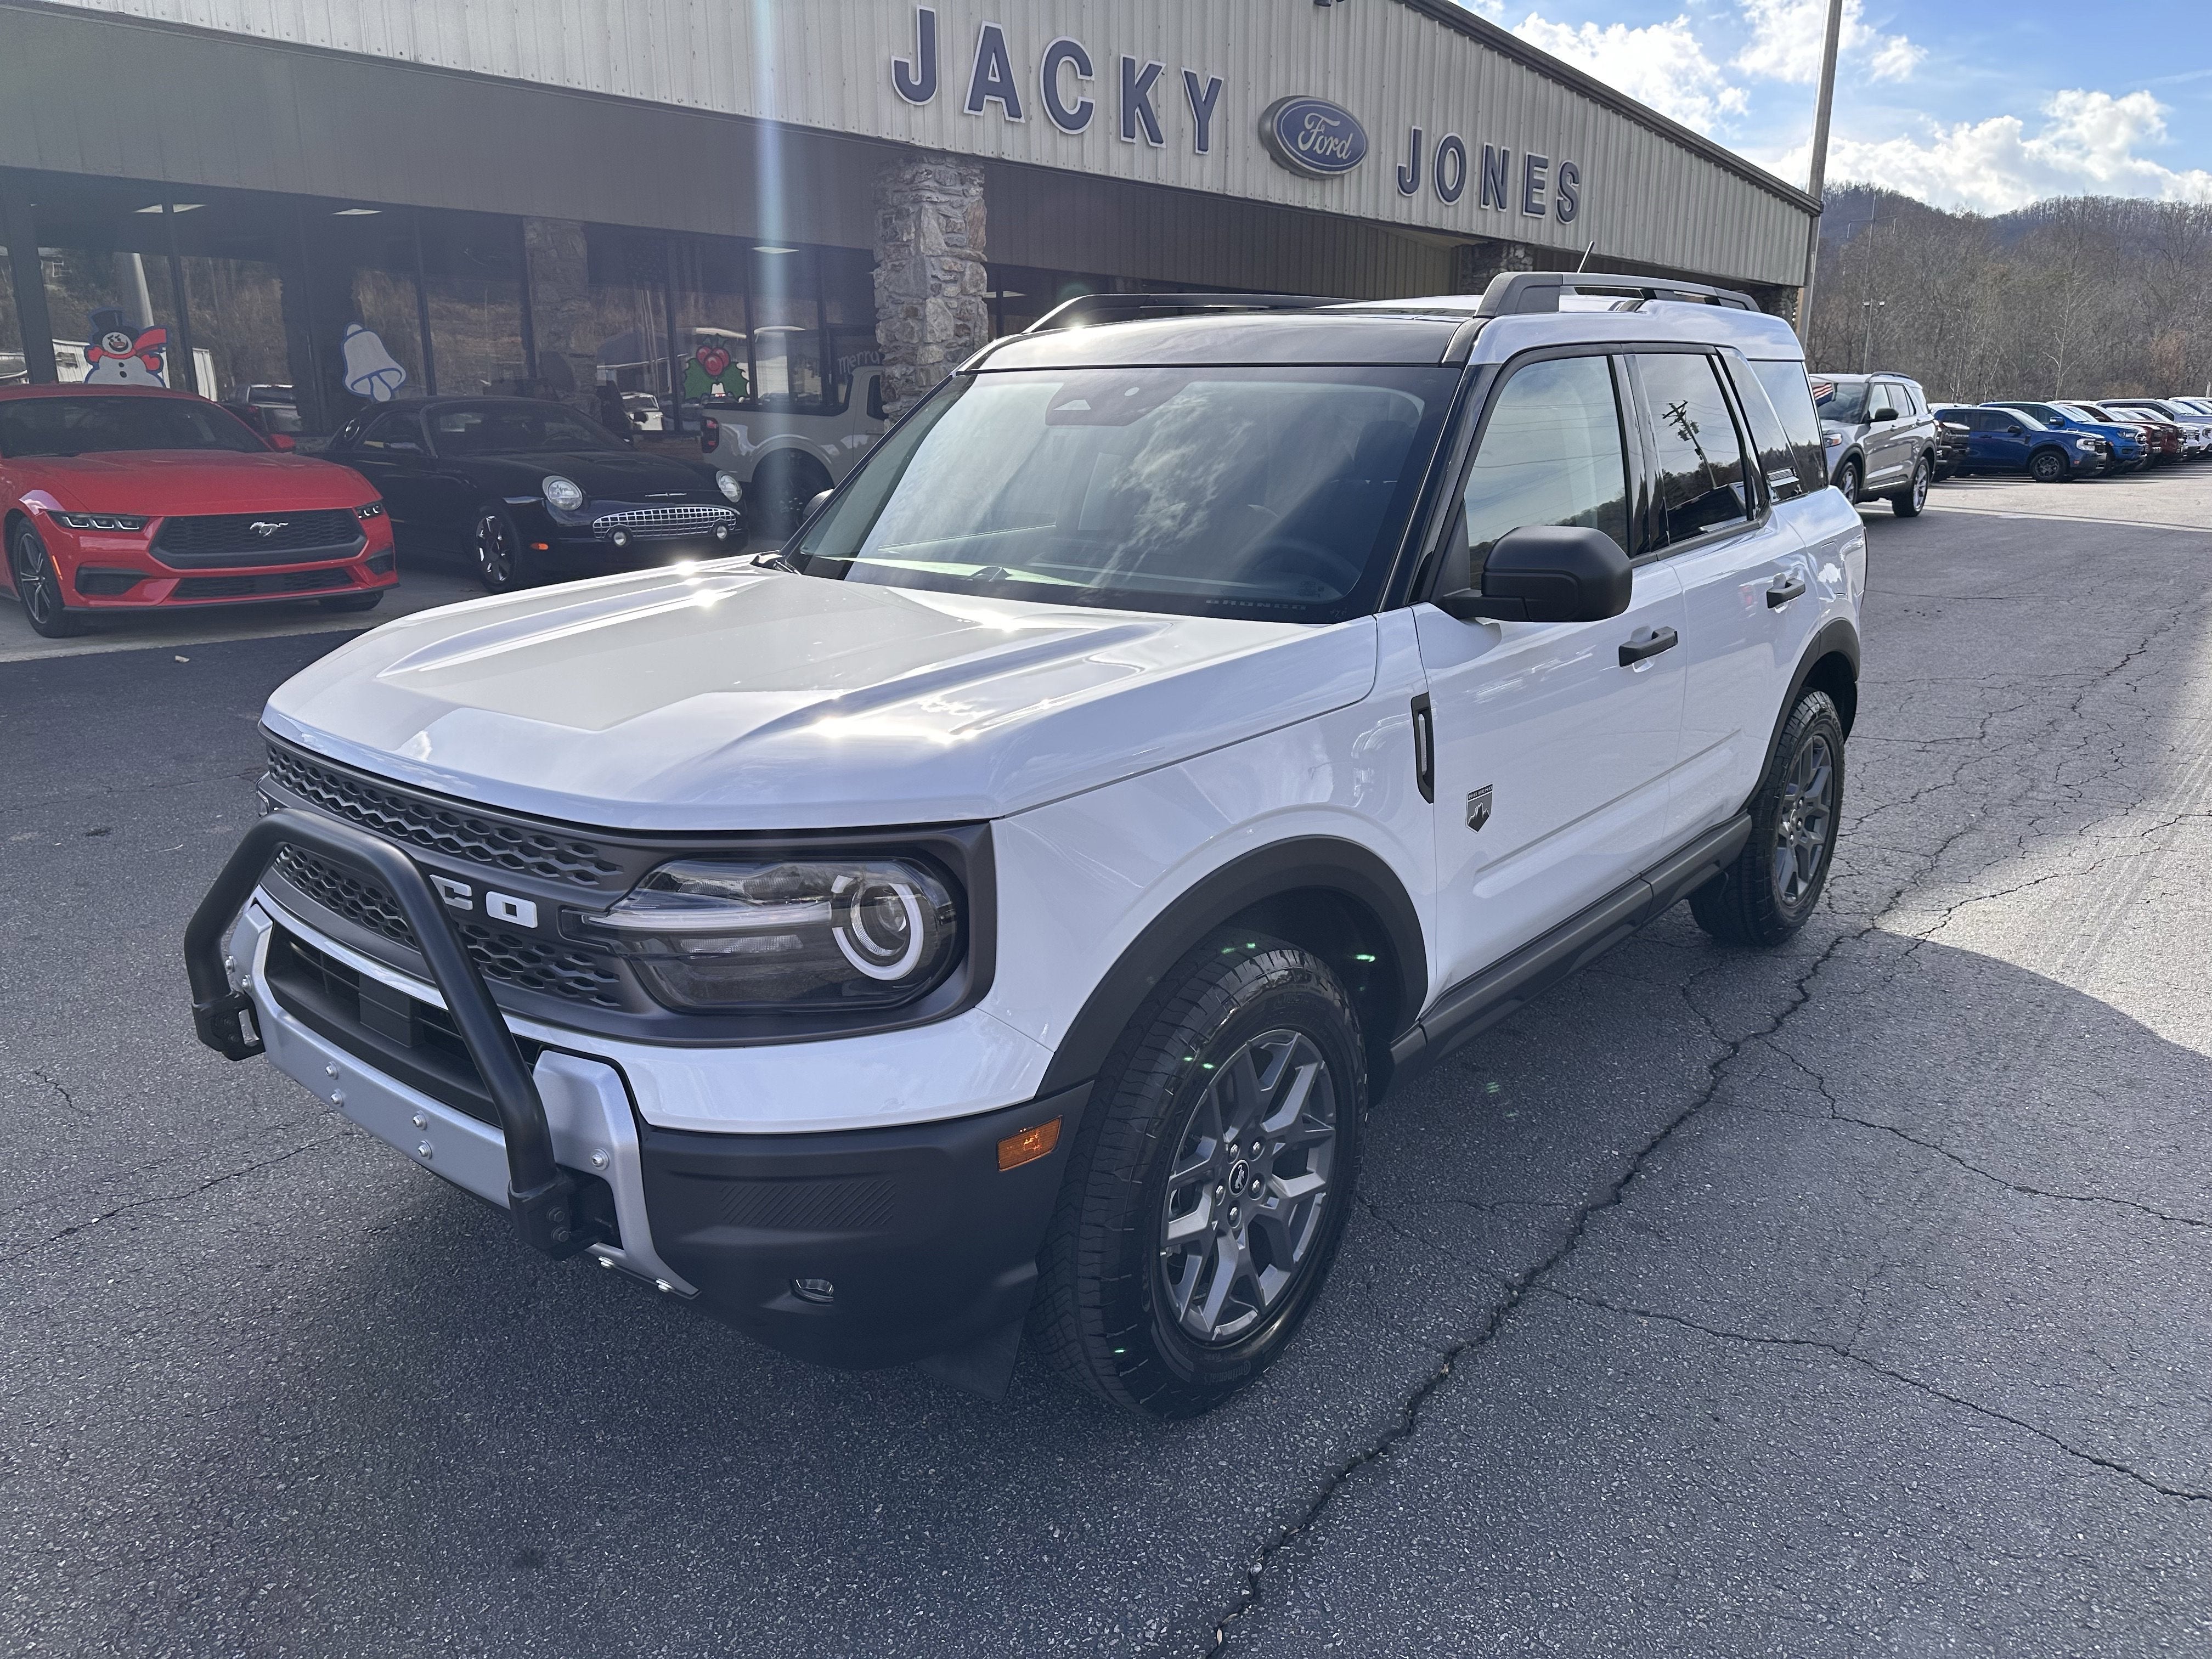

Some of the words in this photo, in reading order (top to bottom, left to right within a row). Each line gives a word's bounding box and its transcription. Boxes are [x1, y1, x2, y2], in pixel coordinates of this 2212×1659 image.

[891, 4, 1224, 154] JACKY
[1397, 126, 1579, 224] JONES
[1298, 112, 1353, 159] Ford
[1478, 786, 1492, 795] BEND
